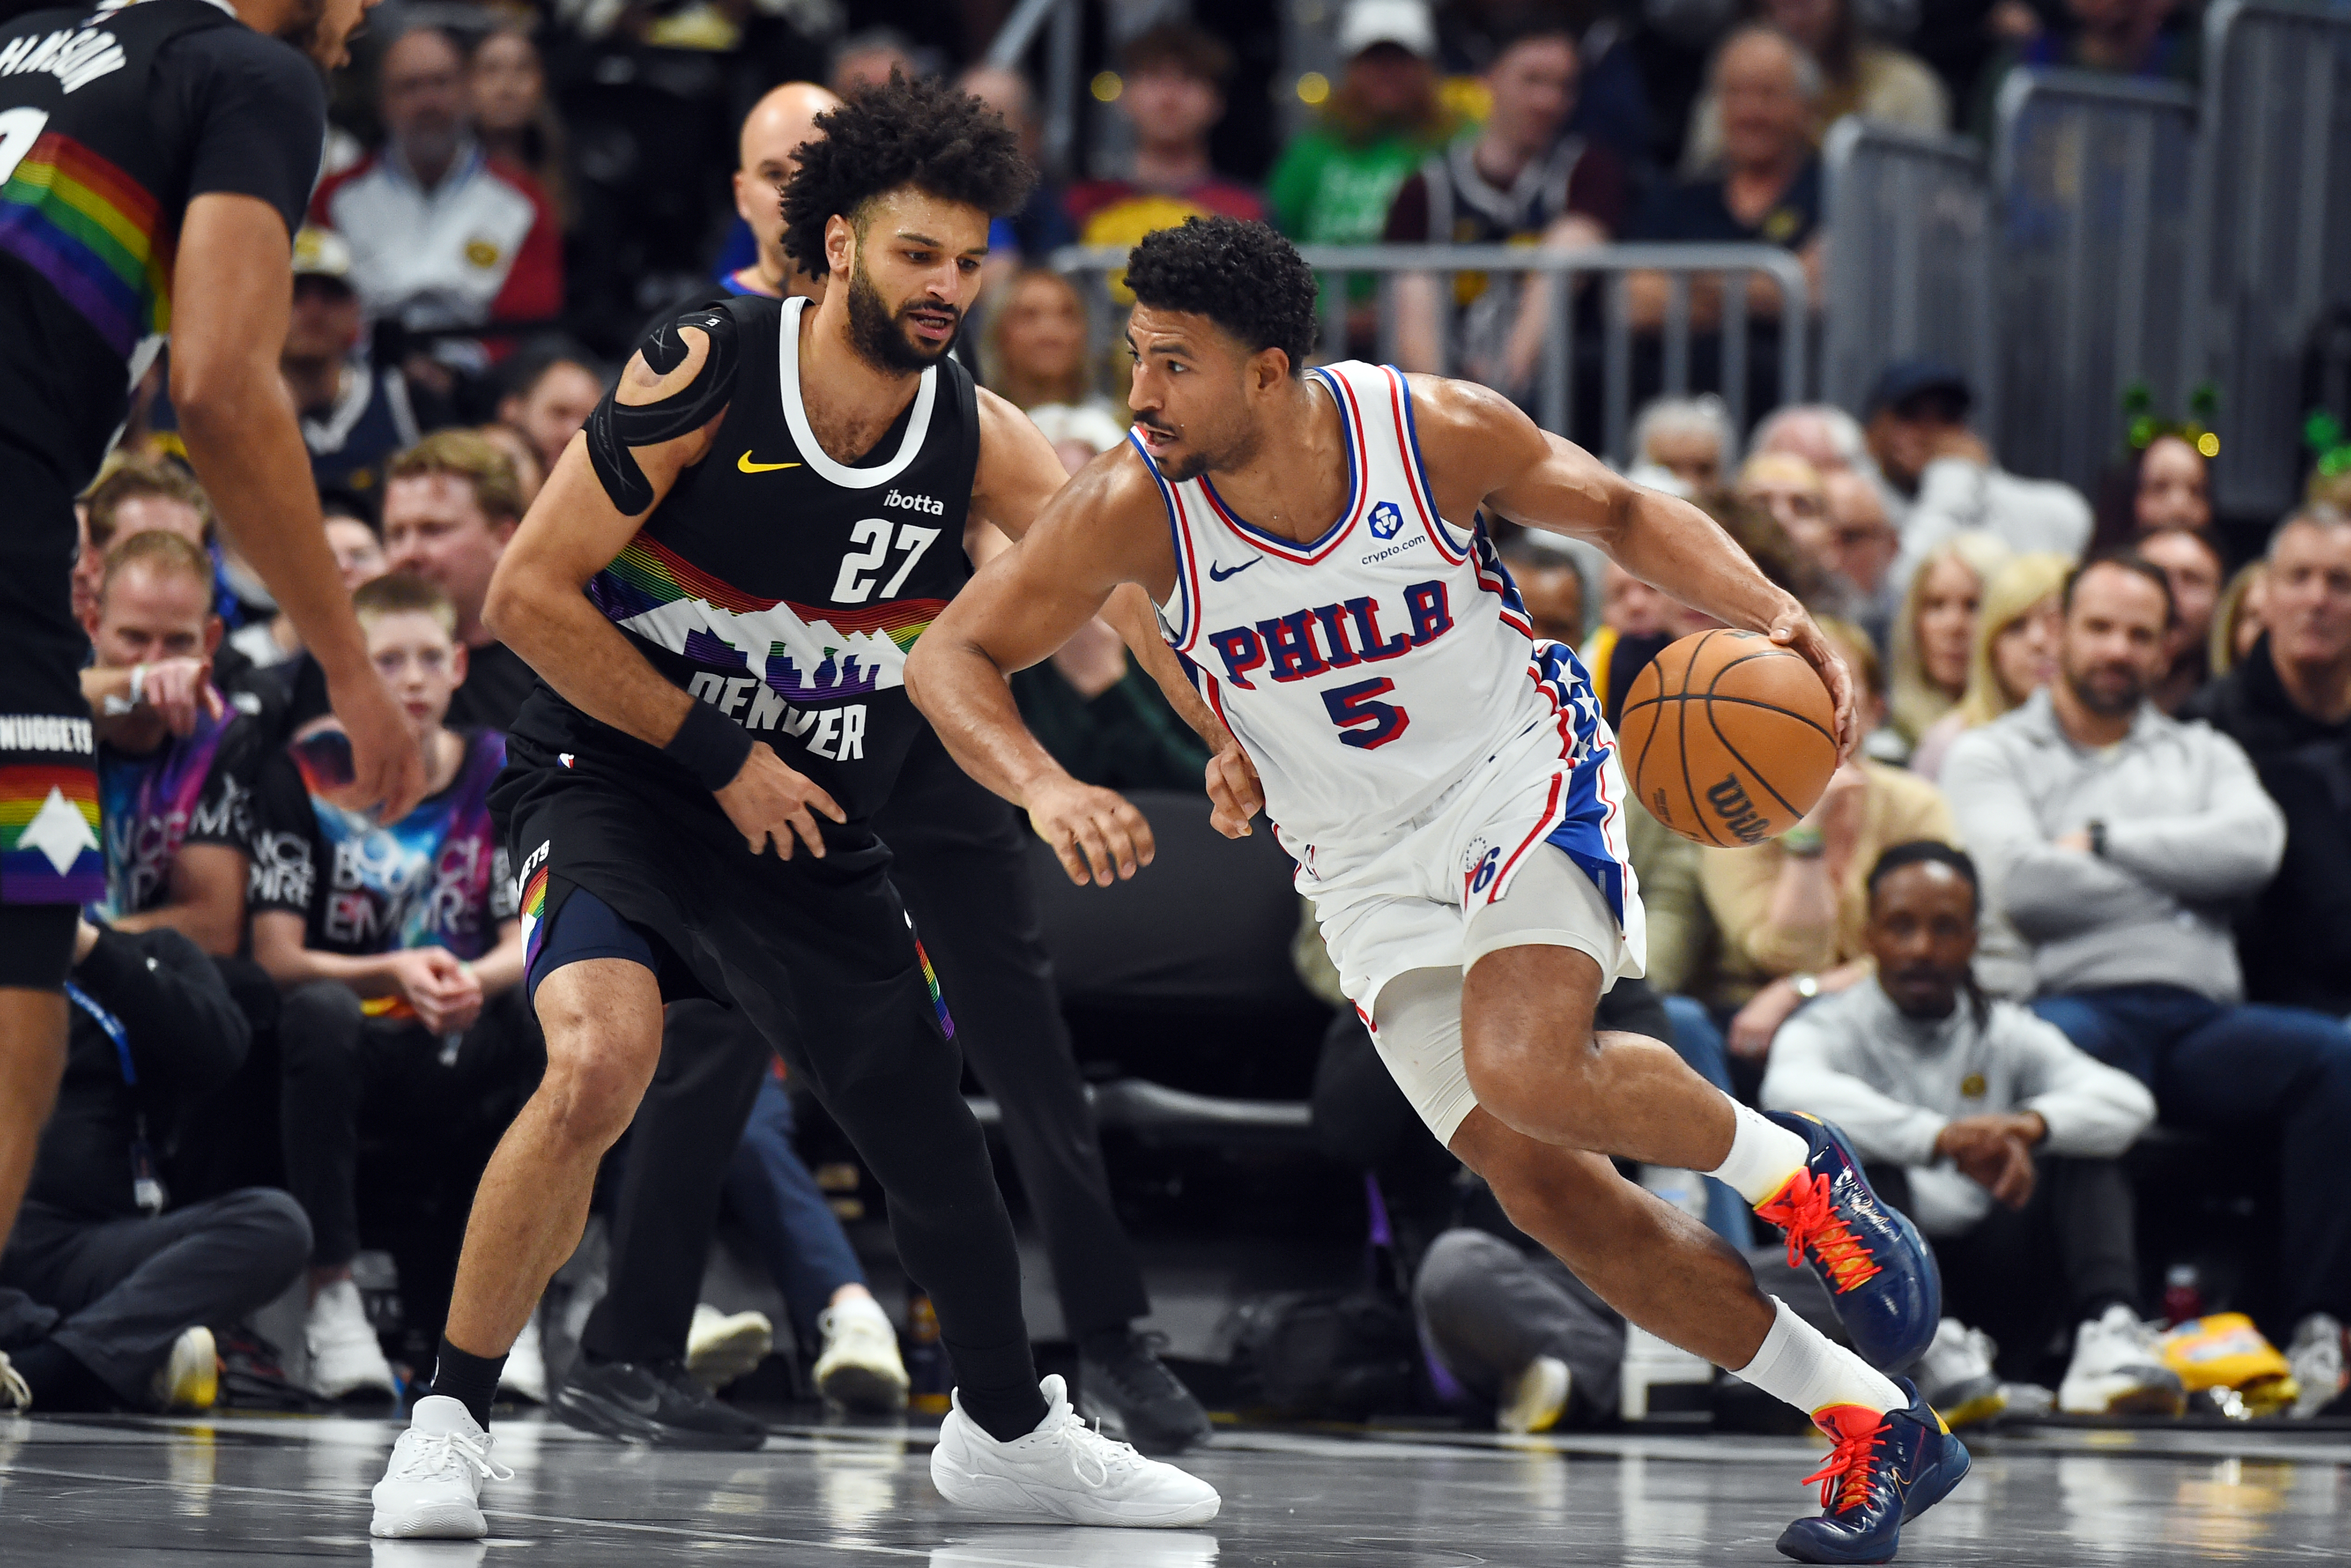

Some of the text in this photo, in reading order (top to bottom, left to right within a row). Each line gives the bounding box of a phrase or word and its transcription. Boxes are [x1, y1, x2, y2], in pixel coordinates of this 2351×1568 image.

[883, 490, 944, 516] ibotta
[830, 518, 942, 603] 27
[1362, 535, 1426, 565] crypto.com
[1208, 580, 1455, 690] PHILA
[0, 713, 93, 755] NUGGETS
[688, 671, 867, 761] DENVER
[1320, 677, 1410, 750] 5
